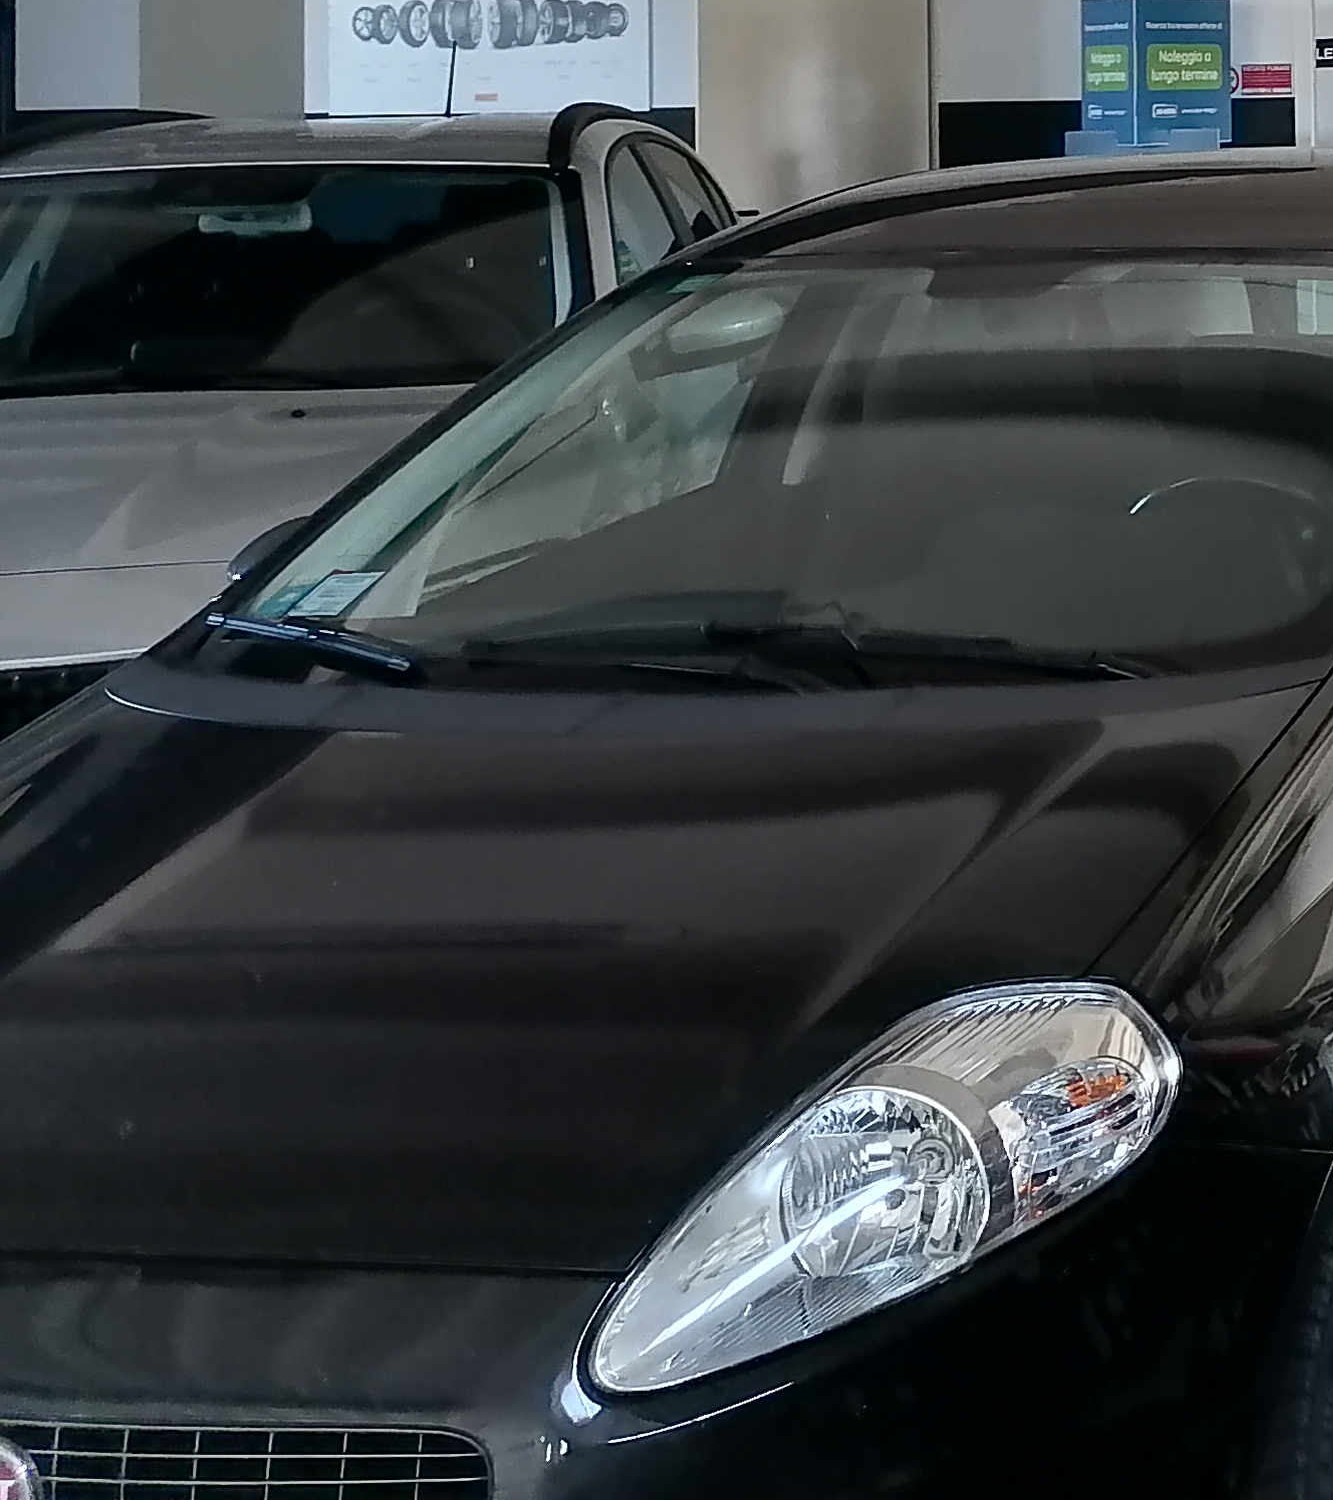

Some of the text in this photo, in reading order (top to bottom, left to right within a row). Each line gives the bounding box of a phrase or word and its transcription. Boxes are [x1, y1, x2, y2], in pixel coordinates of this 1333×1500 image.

[1159, 50, 1212, 65] Noleggio a
[1151, 69, 1219, 84] lungo termine
